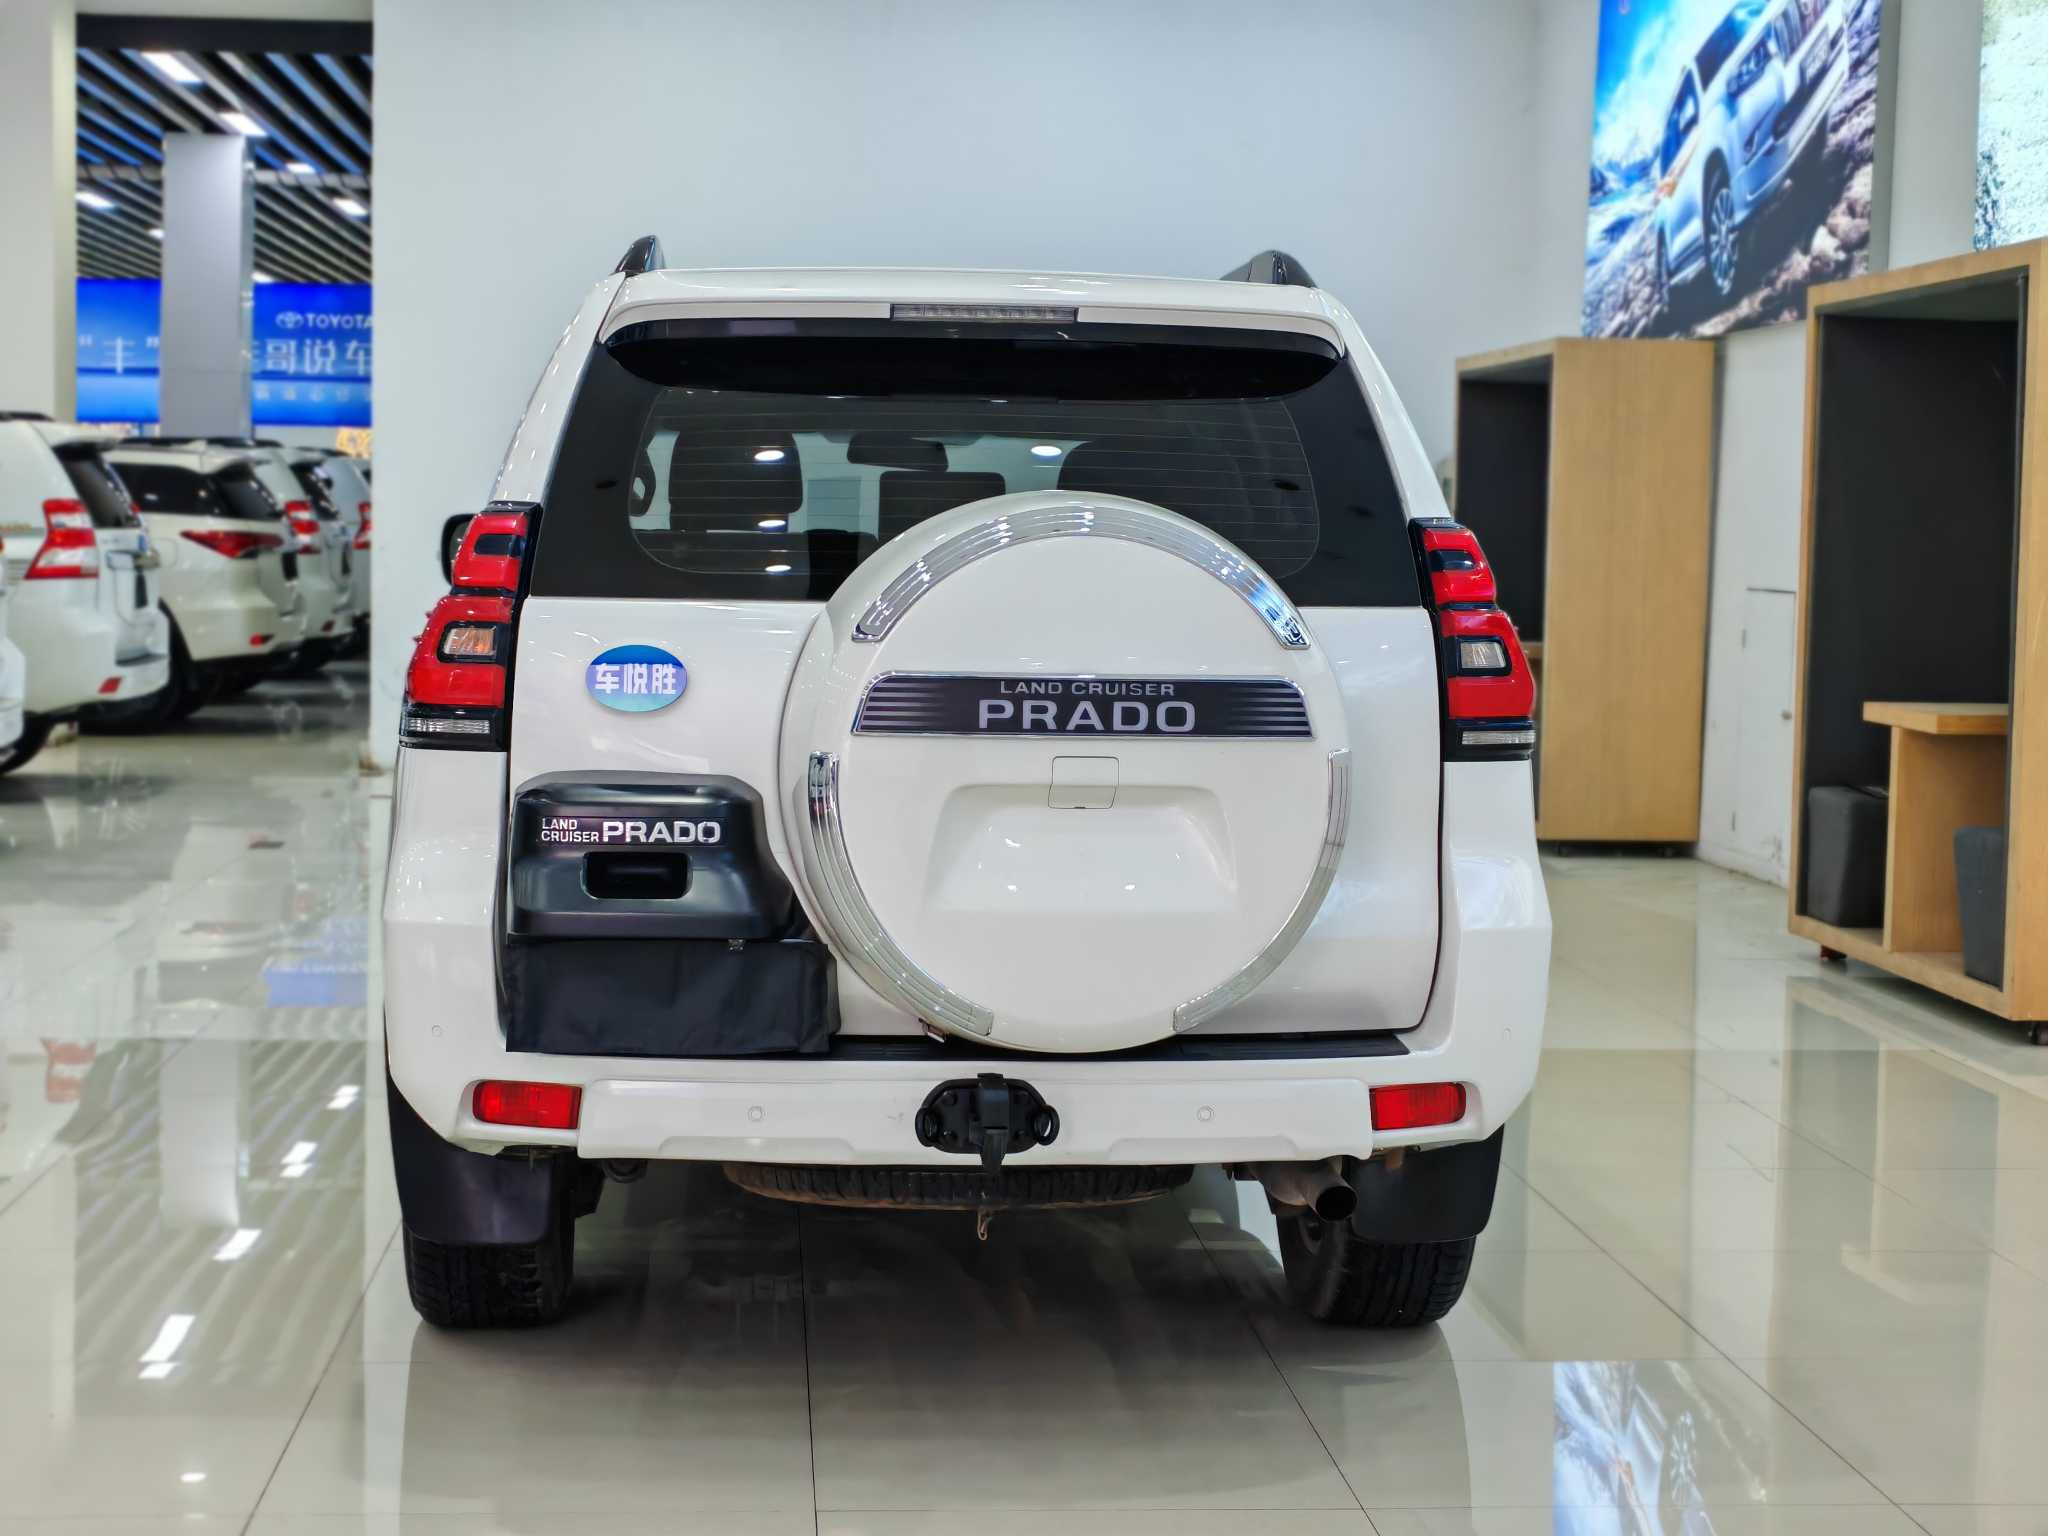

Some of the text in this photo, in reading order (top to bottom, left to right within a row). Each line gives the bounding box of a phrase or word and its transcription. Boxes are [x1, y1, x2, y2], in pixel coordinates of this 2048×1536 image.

[594, 662, 677, 695] 车悦胜
[1000, 681, 1176, 697] LAND CRUISER
[978, 699, 1196, 732] PRADO
[541, 818, 578, 830] LAND
[602, 821, 721, 844] PRADO
[541, 830, 600, 843] CRUISER
